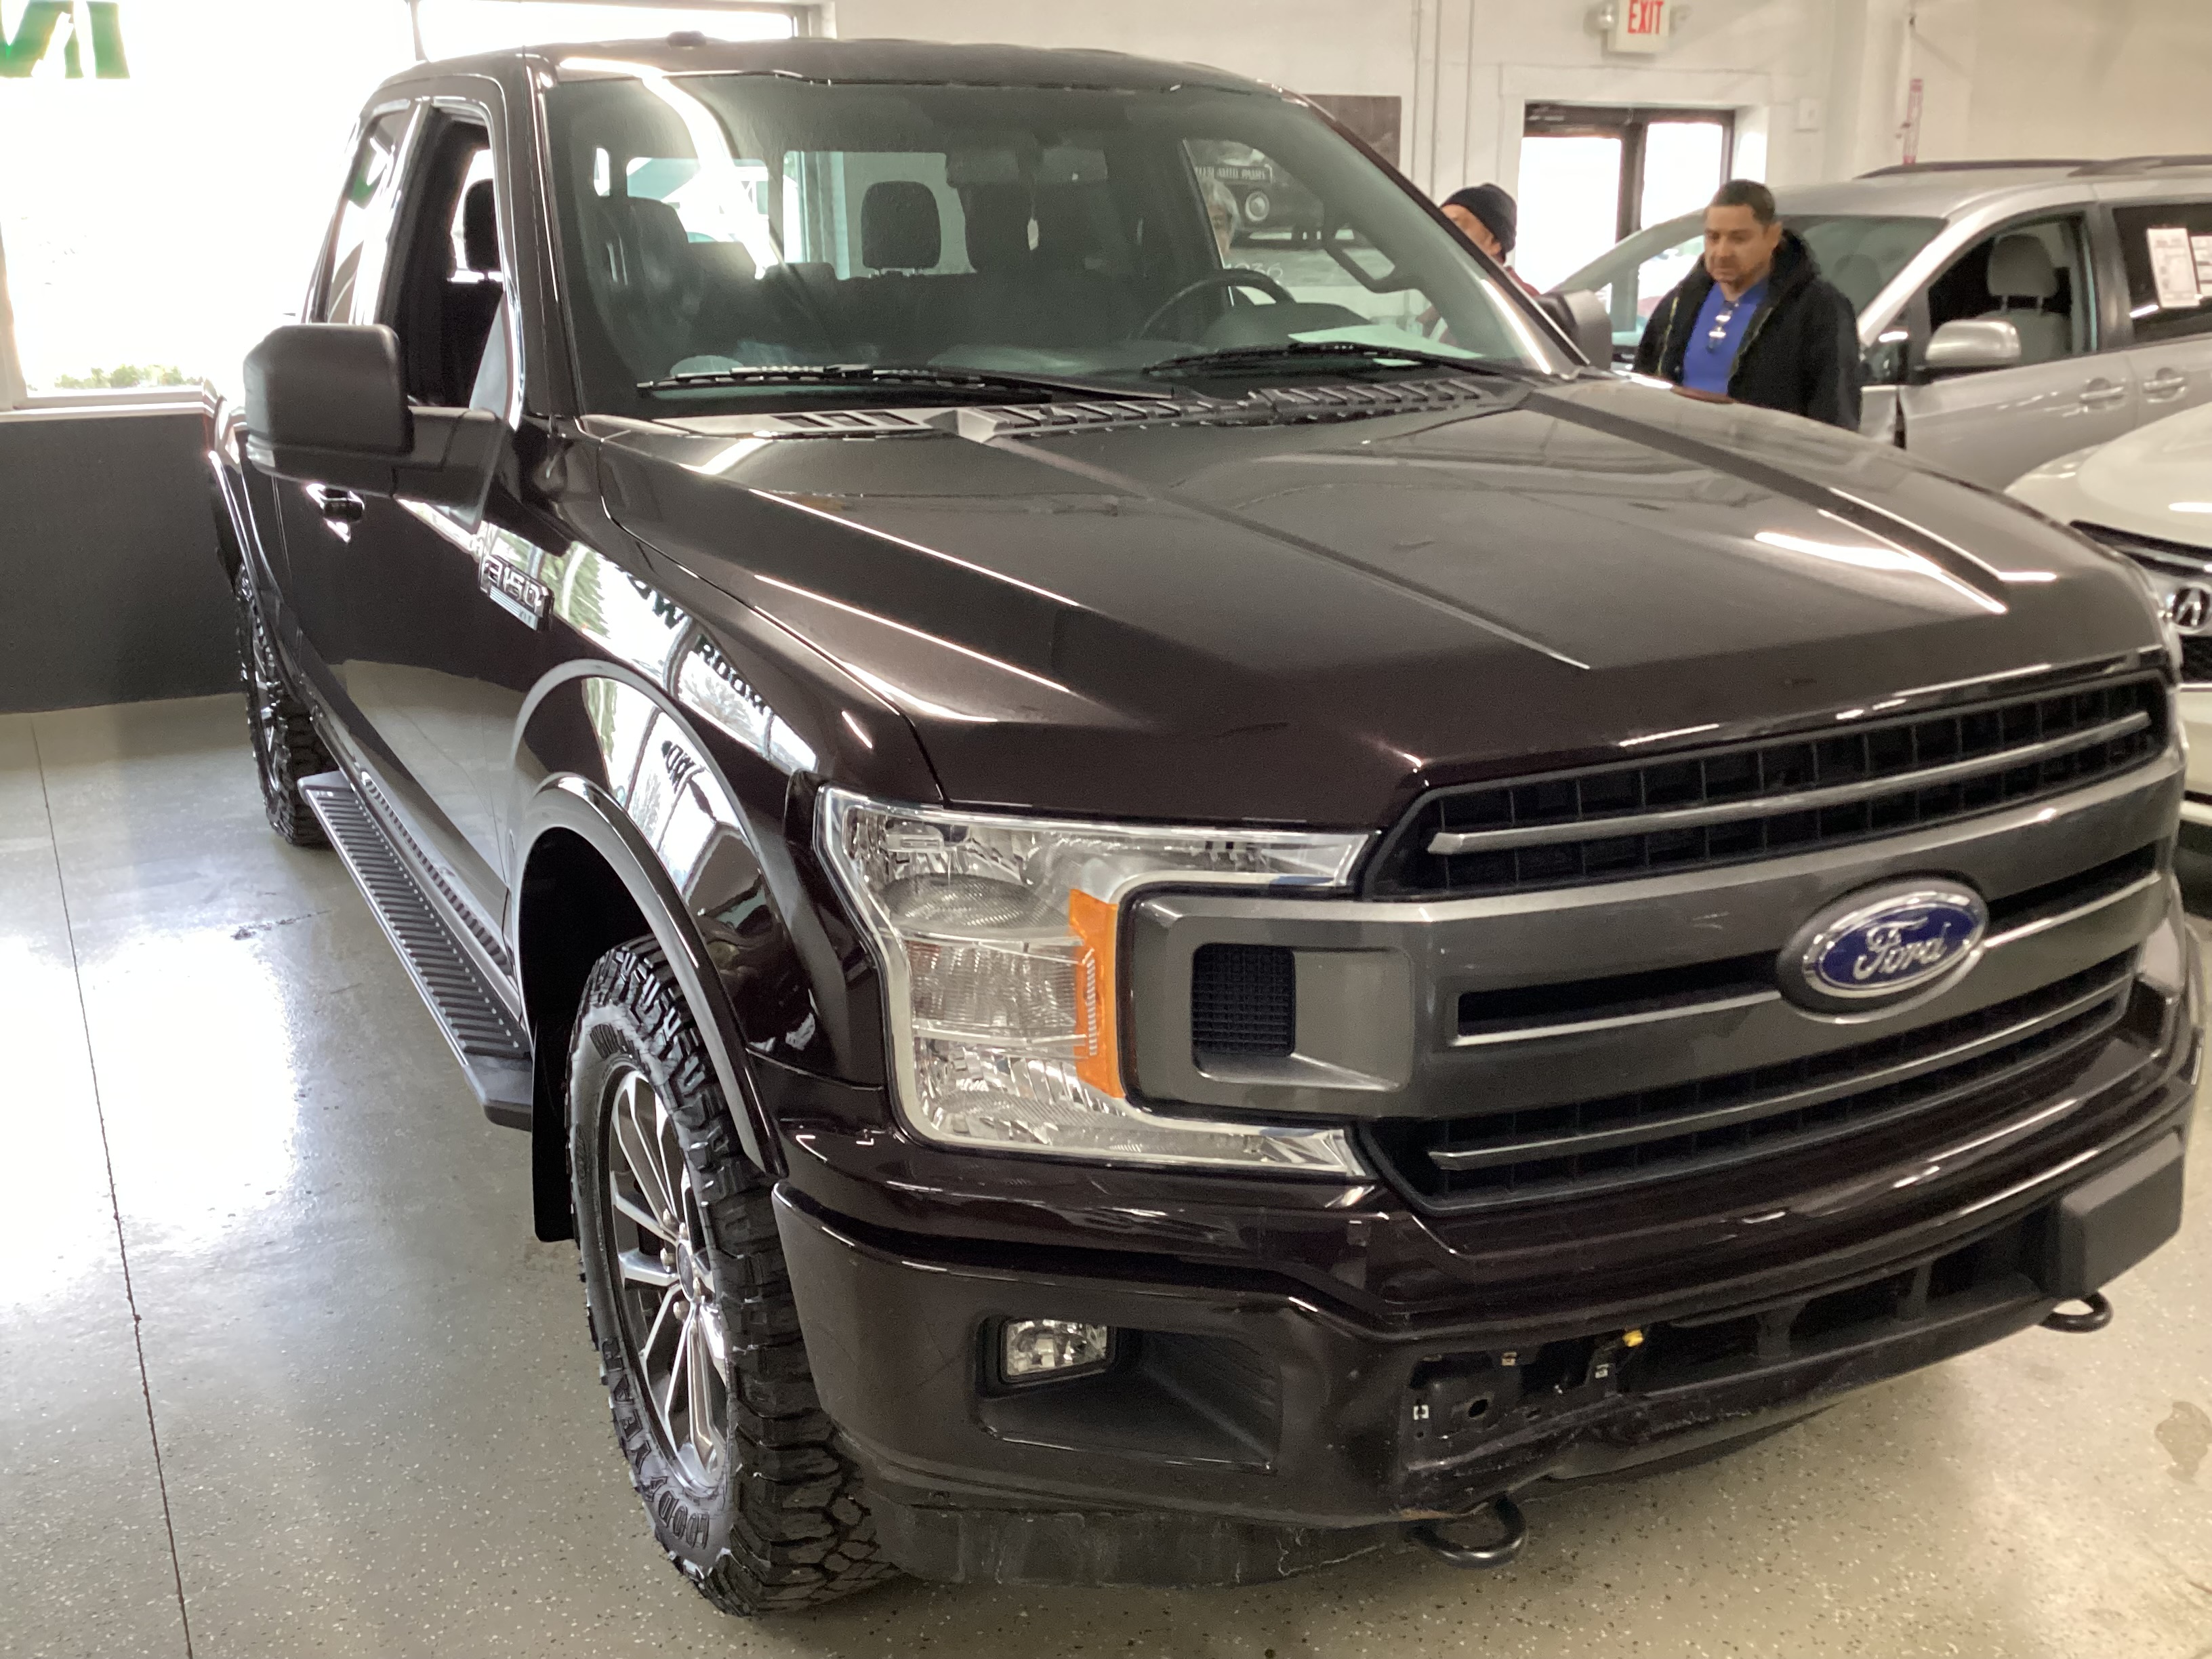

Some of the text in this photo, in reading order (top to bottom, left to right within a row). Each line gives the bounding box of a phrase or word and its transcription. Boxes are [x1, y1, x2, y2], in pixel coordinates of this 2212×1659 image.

[1628, 0, 1664, 35] EXIT
[1853, 917, 1952, 980] Ford
[600, 1336, 710, 1550] GOODYEAR
